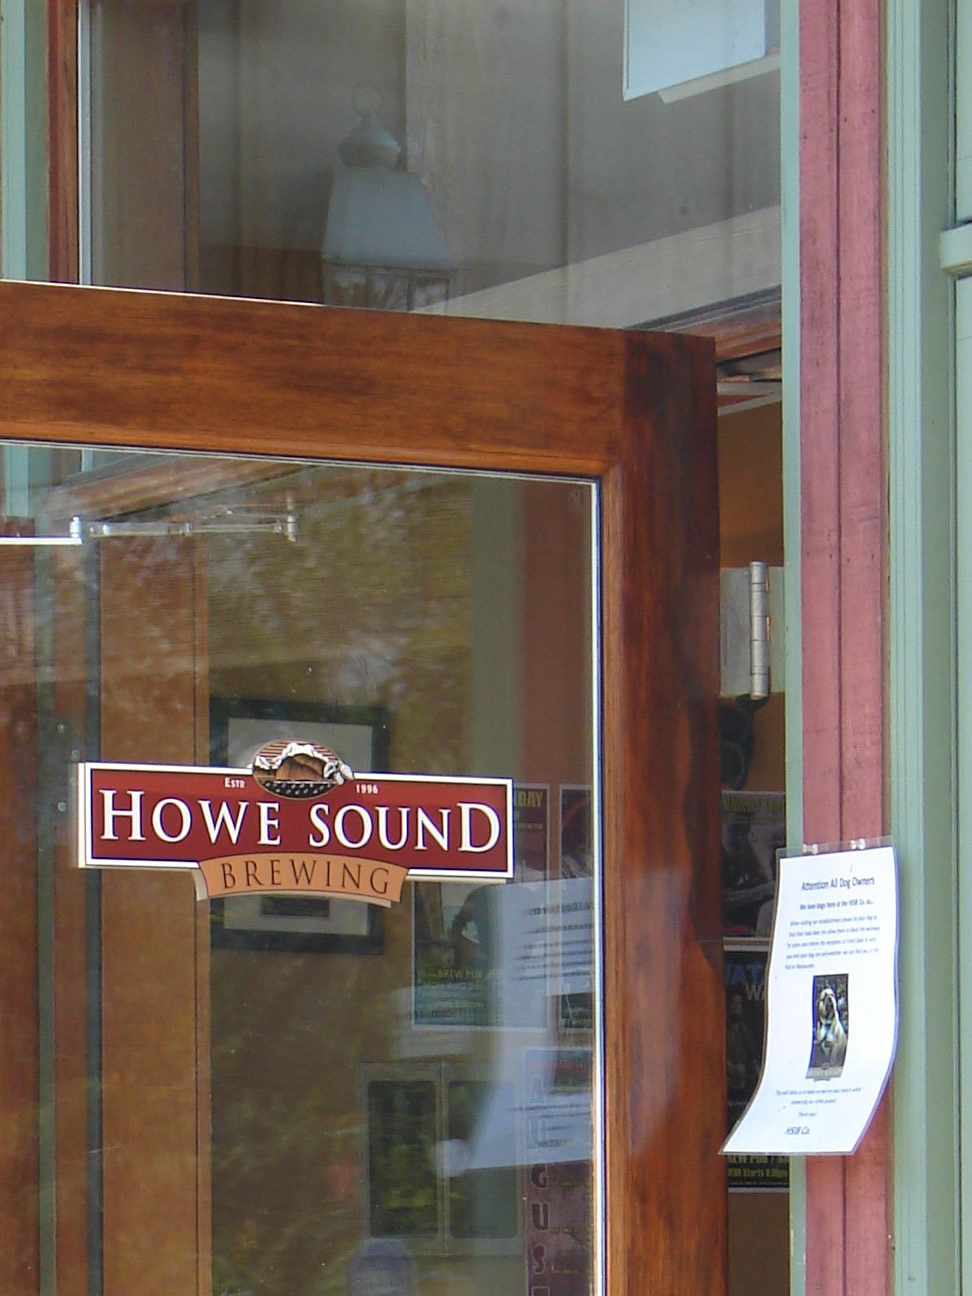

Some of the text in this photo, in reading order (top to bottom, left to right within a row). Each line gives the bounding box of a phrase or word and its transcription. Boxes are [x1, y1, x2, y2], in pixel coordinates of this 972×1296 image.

[356, 784, 379, 794] 1996
[99, 788, 501, 854] HOWE SOUND
[220, 859, 390, 895] BREWING
[839, 877, 851, 889] Dog
[852, 876, 875, 887] Owners
